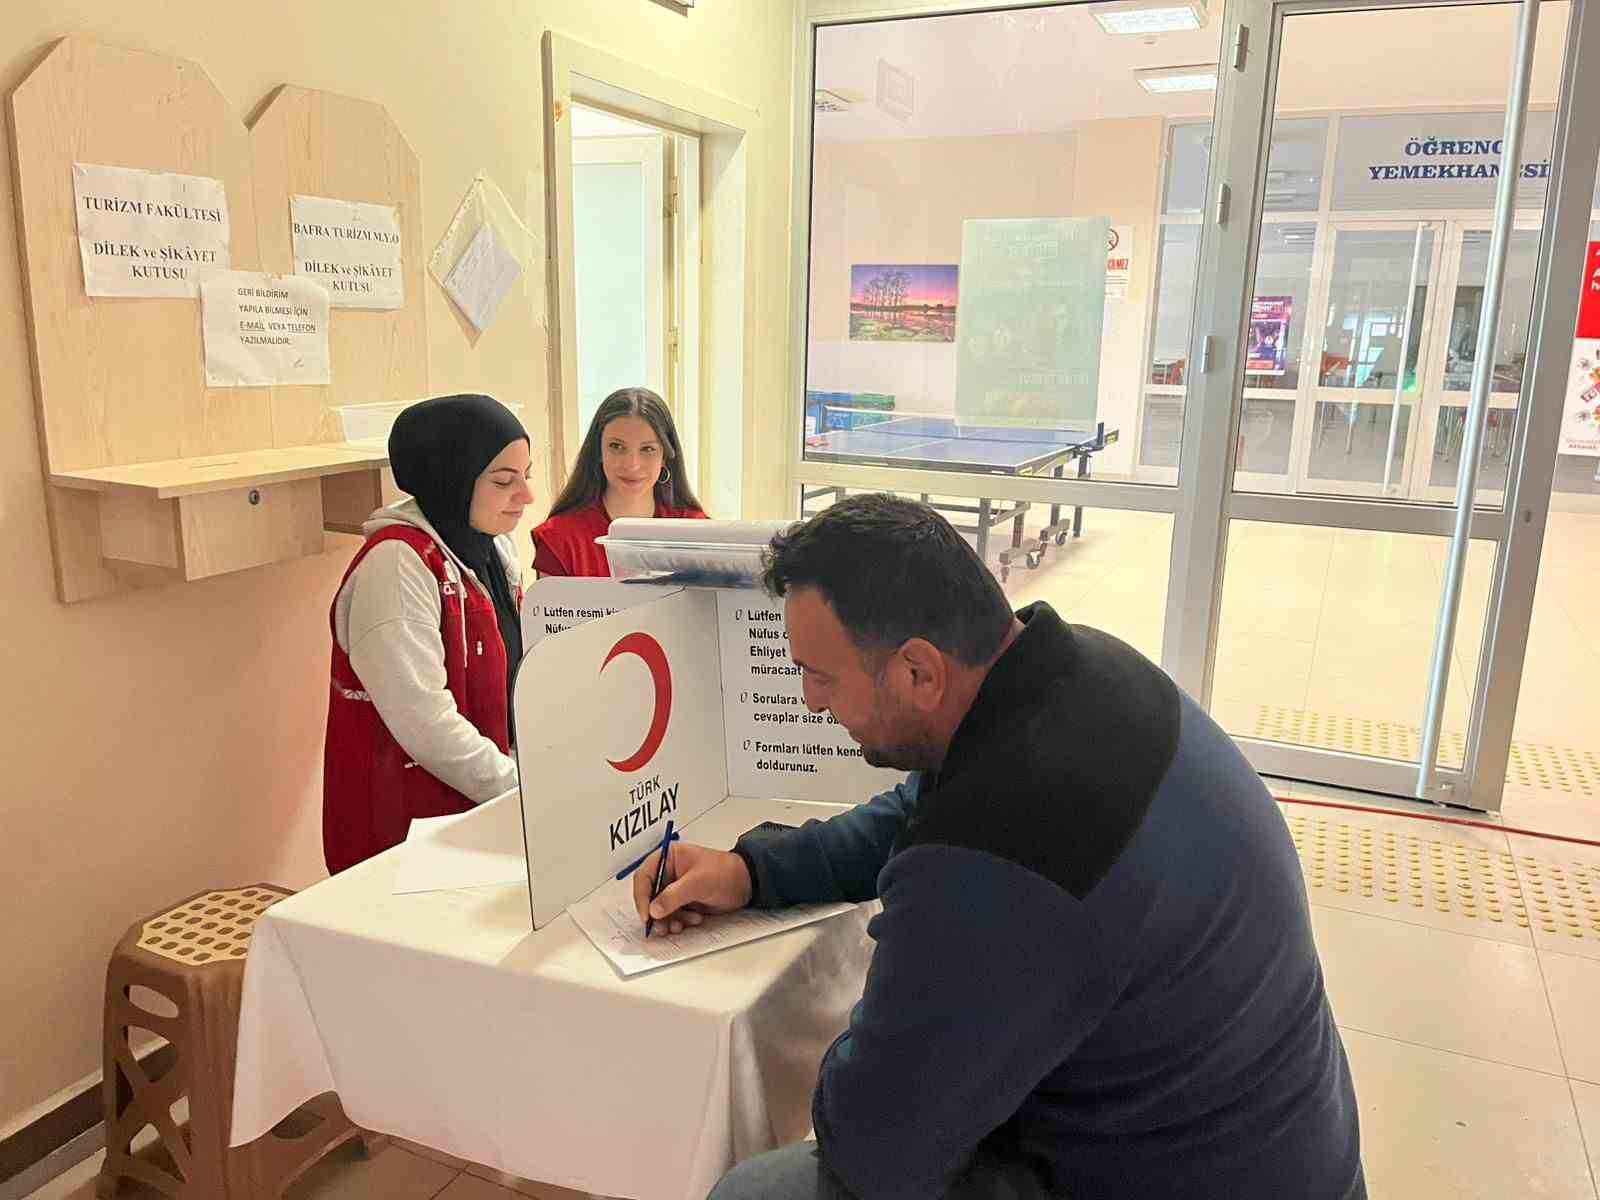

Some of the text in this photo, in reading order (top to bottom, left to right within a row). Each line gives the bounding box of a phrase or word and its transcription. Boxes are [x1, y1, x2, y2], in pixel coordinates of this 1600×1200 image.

[1405, 137, 1503, 156] ÖĞRENC
[1369, 160, 1550, 180] YEMEKHANSİ
[83, 196, 222, 223] TURİZM FAKÜLTESİ
[294, 223, 330, 237] BAFRA
[333, 227, 371, 240] TURİZM
[94, 240, 216, 262] DİLEK ve ŞİKÂYET
[132, 265, 187, 280] KUTUSU
[304, 260, 393, 279] DİLEK ve ŞİKÂYET
[238, 287, 289, 299] GERİ BİLDİRİM
[333, 280, 372, 293] KUTUSU
[239, 304, 309, 317] YAPILA BİLMESİ İÇİN
[268, 322, 287, 331] VEYA
[287, 323, 316, 334] TELEFON
[543, 606, 574, 617] Lütfen
[576, 607, 604, 618] resmi
[748, 609, 782, 621] Lütfen
[749, 628, 780, 640] Nüfus
[750, 645, 786, 660] Ehliyet
[751, 663, 803, 676] müracaat
[752, 692, 798, 705] Sorulara
[753, 710, 800, 726] cevaplar
[801, 711, 824, 725] size
[755, 741, 801, 755] Formları
[802, 743, 833, 757] lütfen
[756, 758, 818, 773] doldurunuz.
[629, 775, 661, 804] TÜRK
[609, 783, 679, 850] KIZILAY
